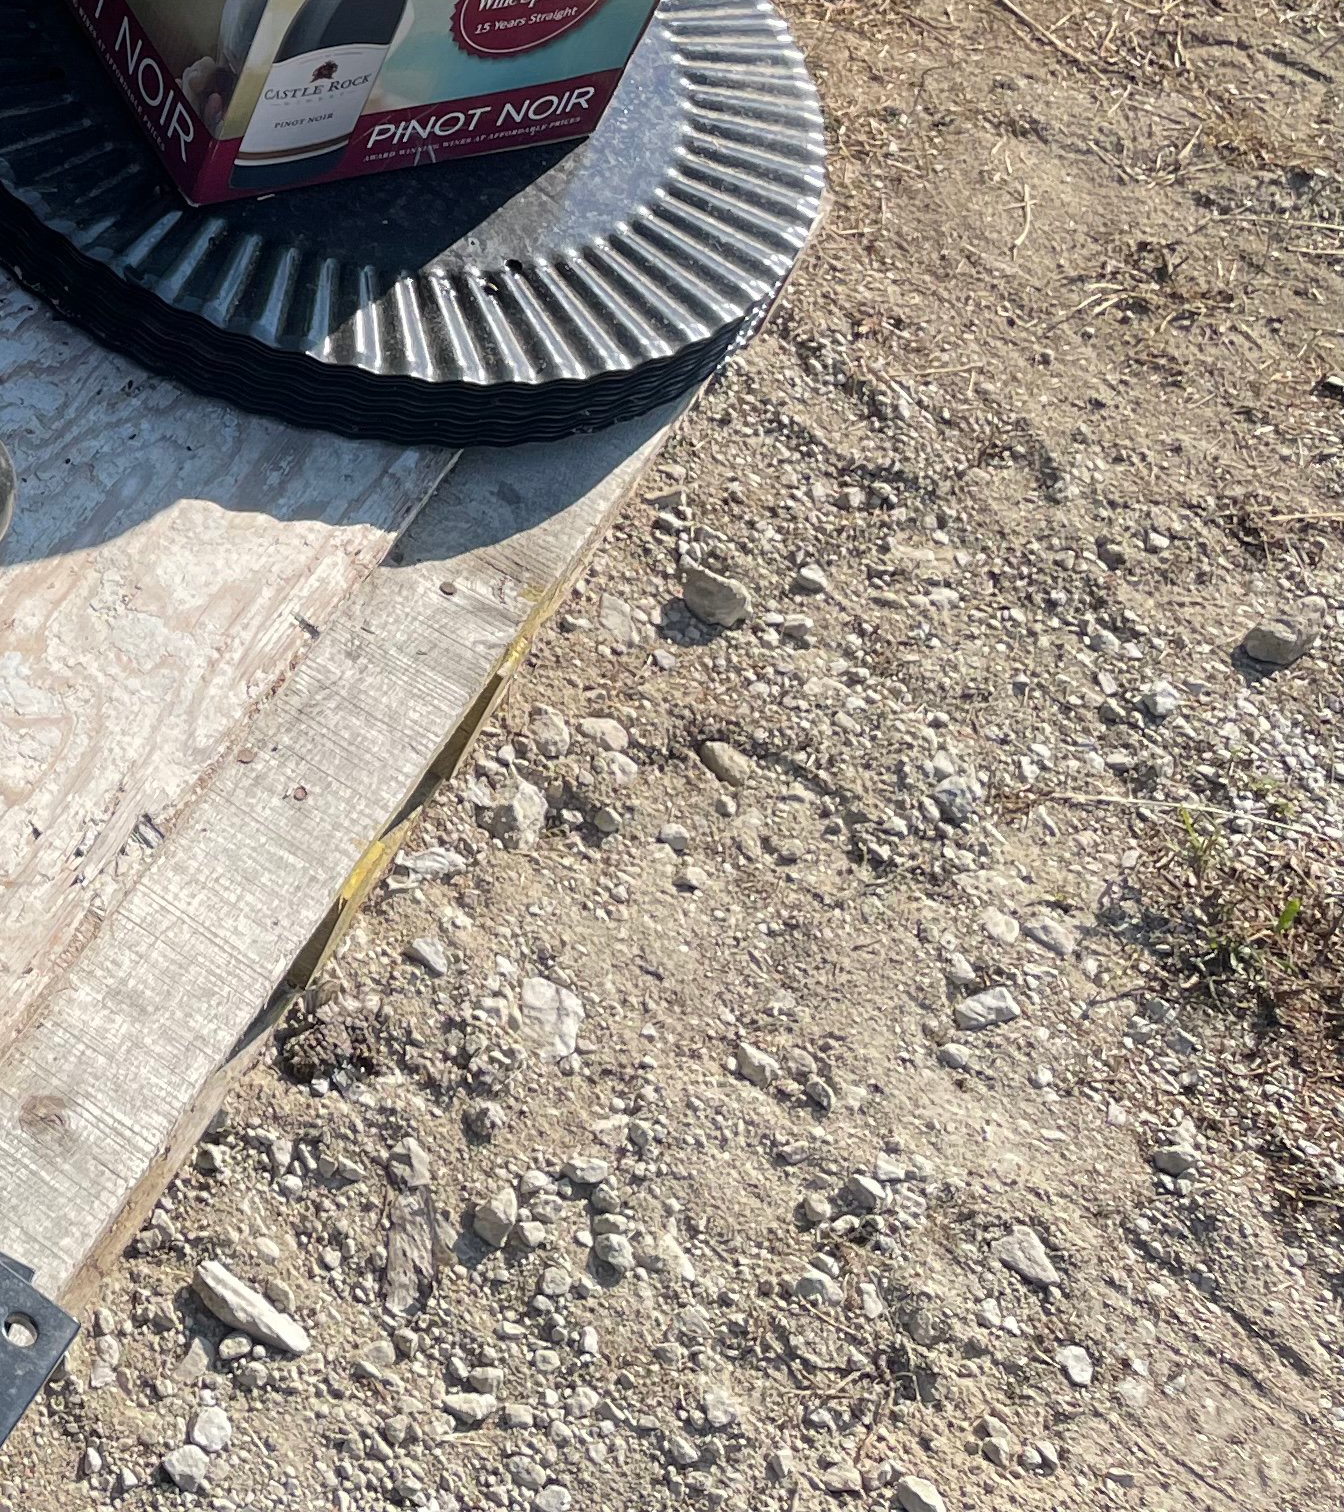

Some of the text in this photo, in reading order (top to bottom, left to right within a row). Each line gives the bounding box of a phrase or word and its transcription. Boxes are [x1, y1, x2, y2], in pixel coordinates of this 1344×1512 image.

[475, 6, 579, 35] 15 Years Straight
[115, 15, 195, 163] NOIR
[264, 84, 325, 101] CASTLE
[327, 73, 372, 93] ROCK
[274, 112, 334, 128] PINOT NOIR
[367, 86, 596, 149] PINOT NOIR
